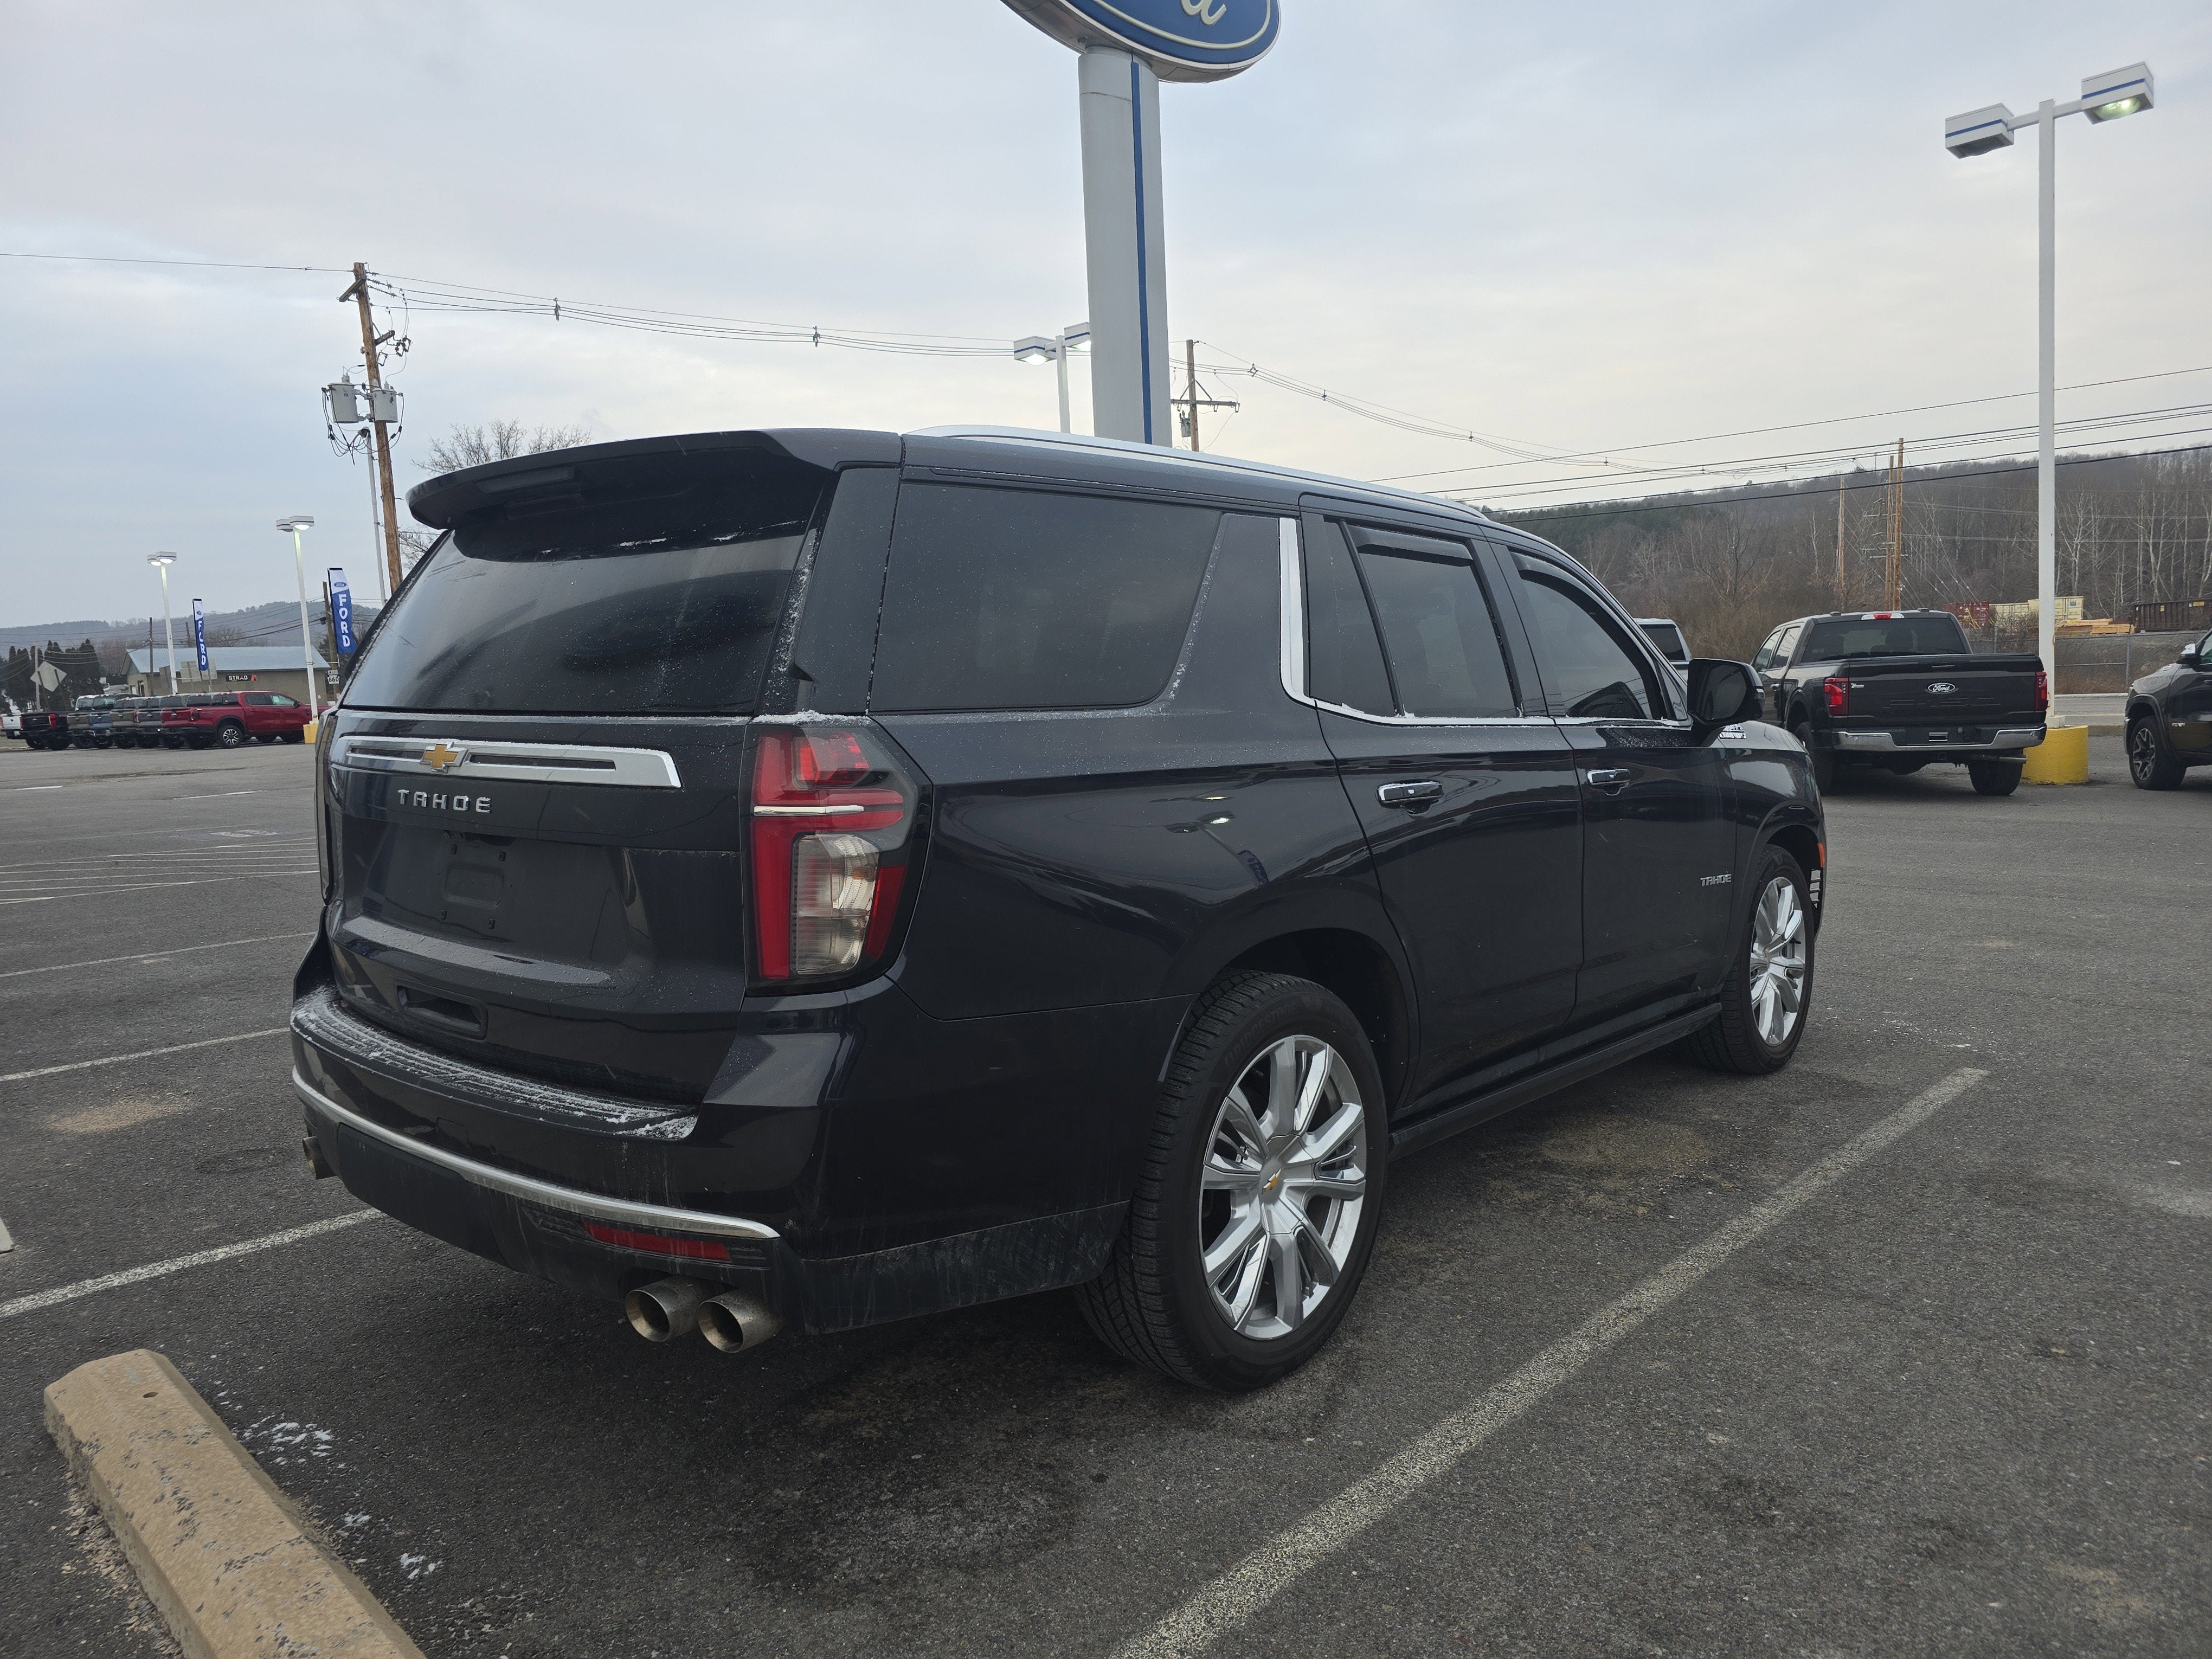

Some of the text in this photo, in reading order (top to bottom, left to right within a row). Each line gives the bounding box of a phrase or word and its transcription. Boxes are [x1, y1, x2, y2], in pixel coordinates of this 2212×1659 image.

[338, 594, 350, 647] FORD
[397, 789, 492, 814] TAHOE
[1700, 874, 1732, 887] TAHOE
